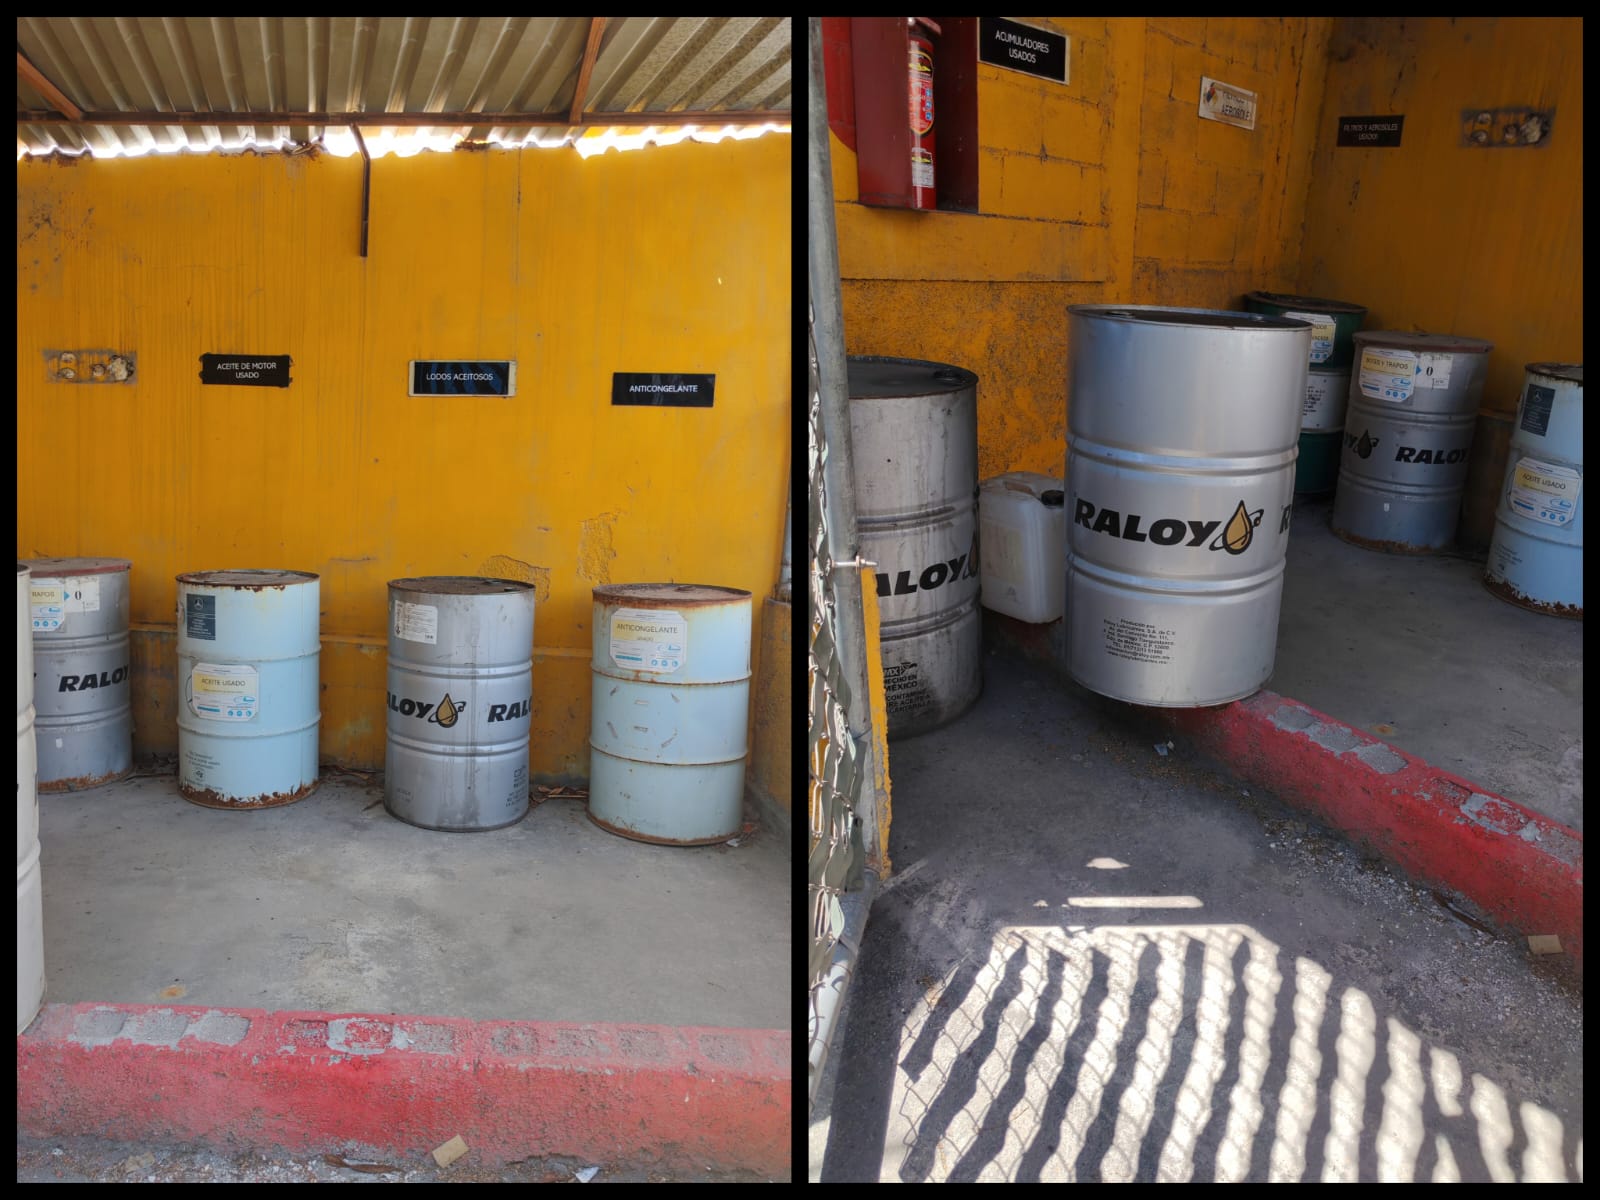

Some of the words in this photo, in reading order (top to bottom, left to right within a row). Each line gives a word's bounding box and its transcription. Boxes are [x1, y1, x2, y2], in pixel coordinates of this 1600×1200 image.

[995, 30, 1049, 53] ACUMULADORES
[1009, 48, 1037, 64] USADOS
[252, 362, 277, 370] MOTOR
[1426, 366, 1434, 377] 0
[453, 373, 494, 381] ACEITOSOS
[629, 384, 698, 393] ANTICONGELANTE
[1542, 480, 1566, 490] USADO
[1074, 498, 1222, 547] RALOY
[75, 591, 82, 601] 0
[616, 623, 679, 634] ANTICONGELANTE
